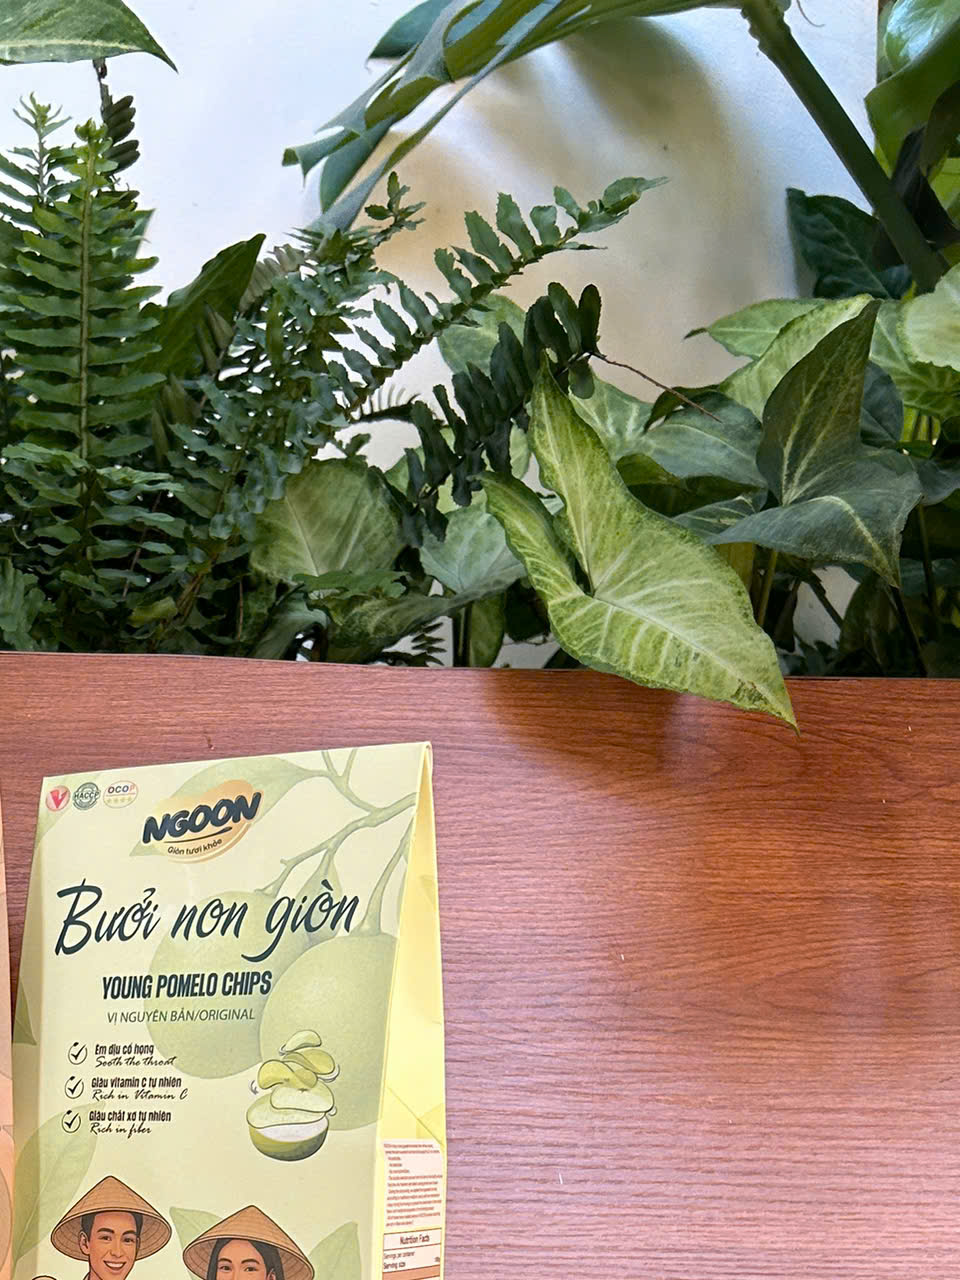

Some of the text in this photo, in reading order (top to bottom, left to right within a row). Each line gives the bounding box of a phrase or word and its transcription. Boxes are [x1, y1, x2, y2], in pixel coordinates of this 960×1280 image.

[74, 791, 100, 800] HACCP
[107, 784, 136, 794] OCOP
[142, 791, 262, 844] NGOON
[167, 846, 184, 855] Giòn
[186, 847, 202, 855] tươi
[54, 878, 359, 963] Bưởi non giòn
[102, 970, 273, 1000] YOUNG POMELO CHIPS
[107, 1007, 255, 1026] VỊ NGUYÊN BẢN/ORIGINAL
[142, 1056, 178, 1066] throat
[110, 1076, 139, 1088] vitamin
[141, 1077, 147, 1088] C
[92, 1088, 189, 1102] Rich in Vitamin C
[90, 1121, 152, 1139] Rich in fiber
